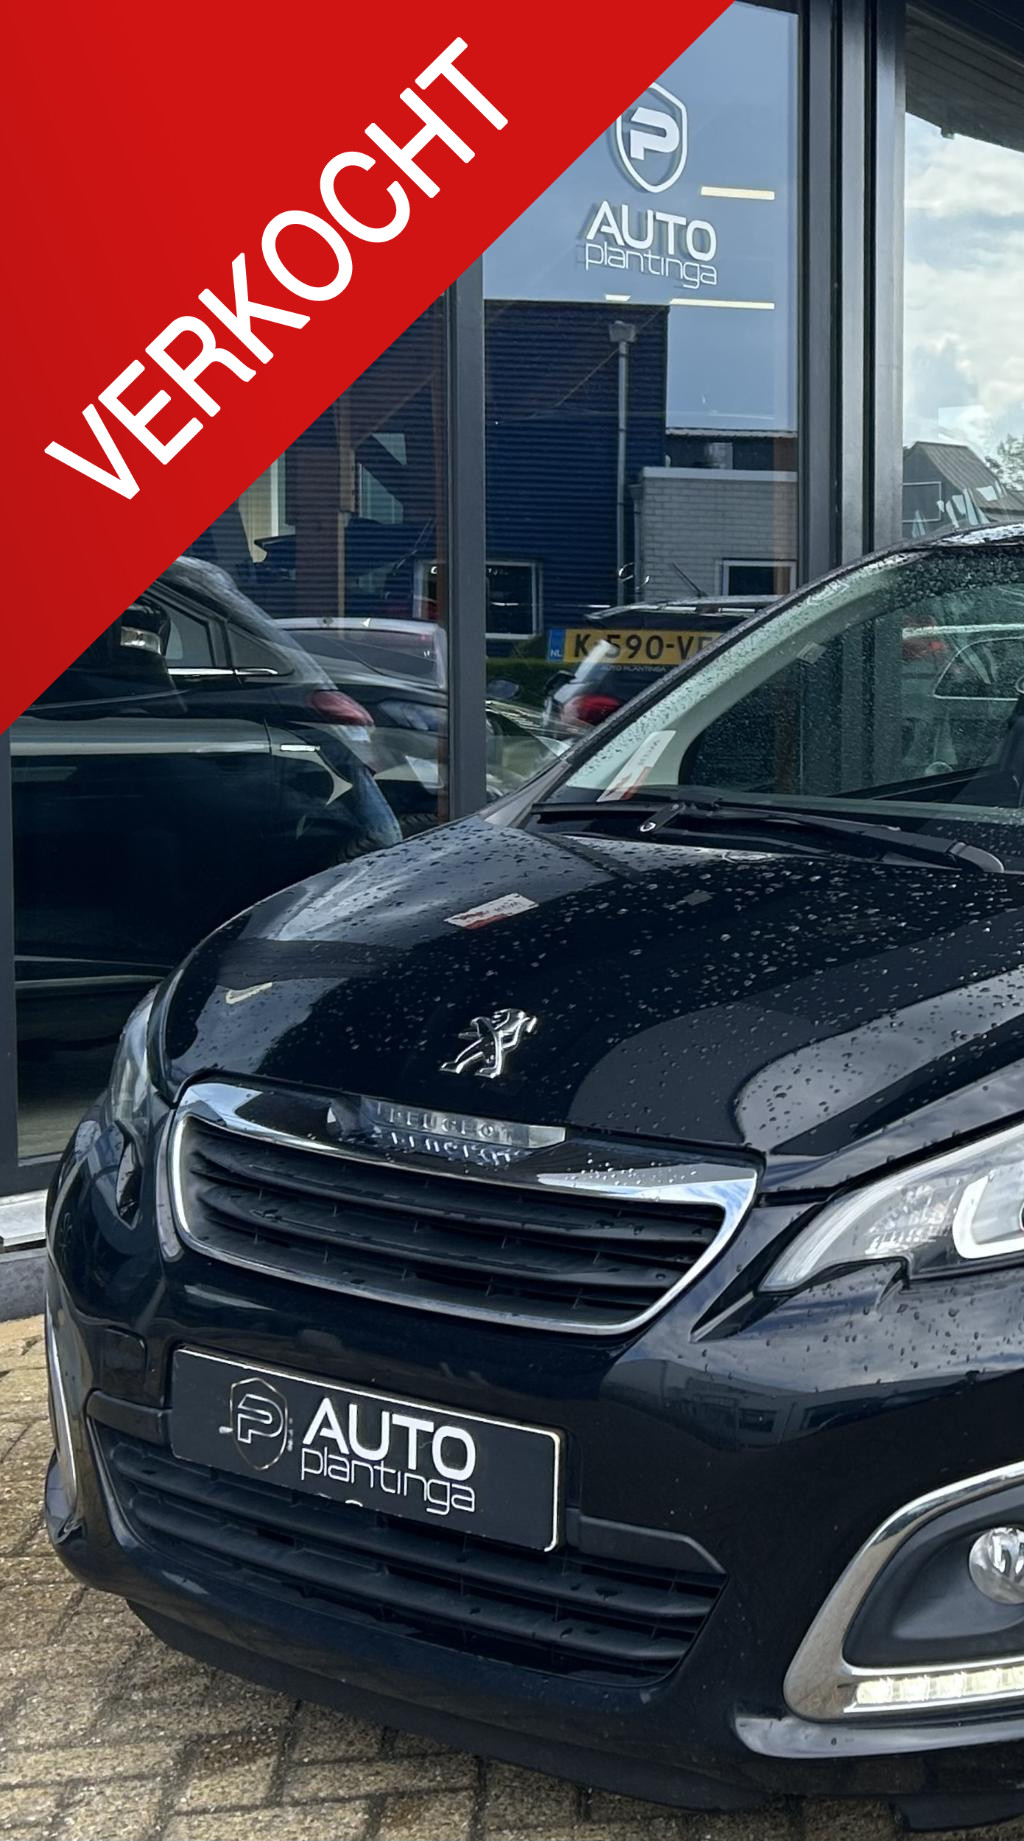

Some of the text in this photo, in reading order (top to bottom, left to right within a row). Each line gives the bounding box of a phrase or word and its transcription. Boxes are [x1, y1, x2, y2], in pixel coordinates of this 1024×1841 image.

[586, 200, 718, 262] AUTO
[585, 241, 718, 290] plantinga
[550, 649, 563, 659] NL
[303, 1398, 476, 1482] AUTO
[301, 1446, 476, 1516] plantinga
